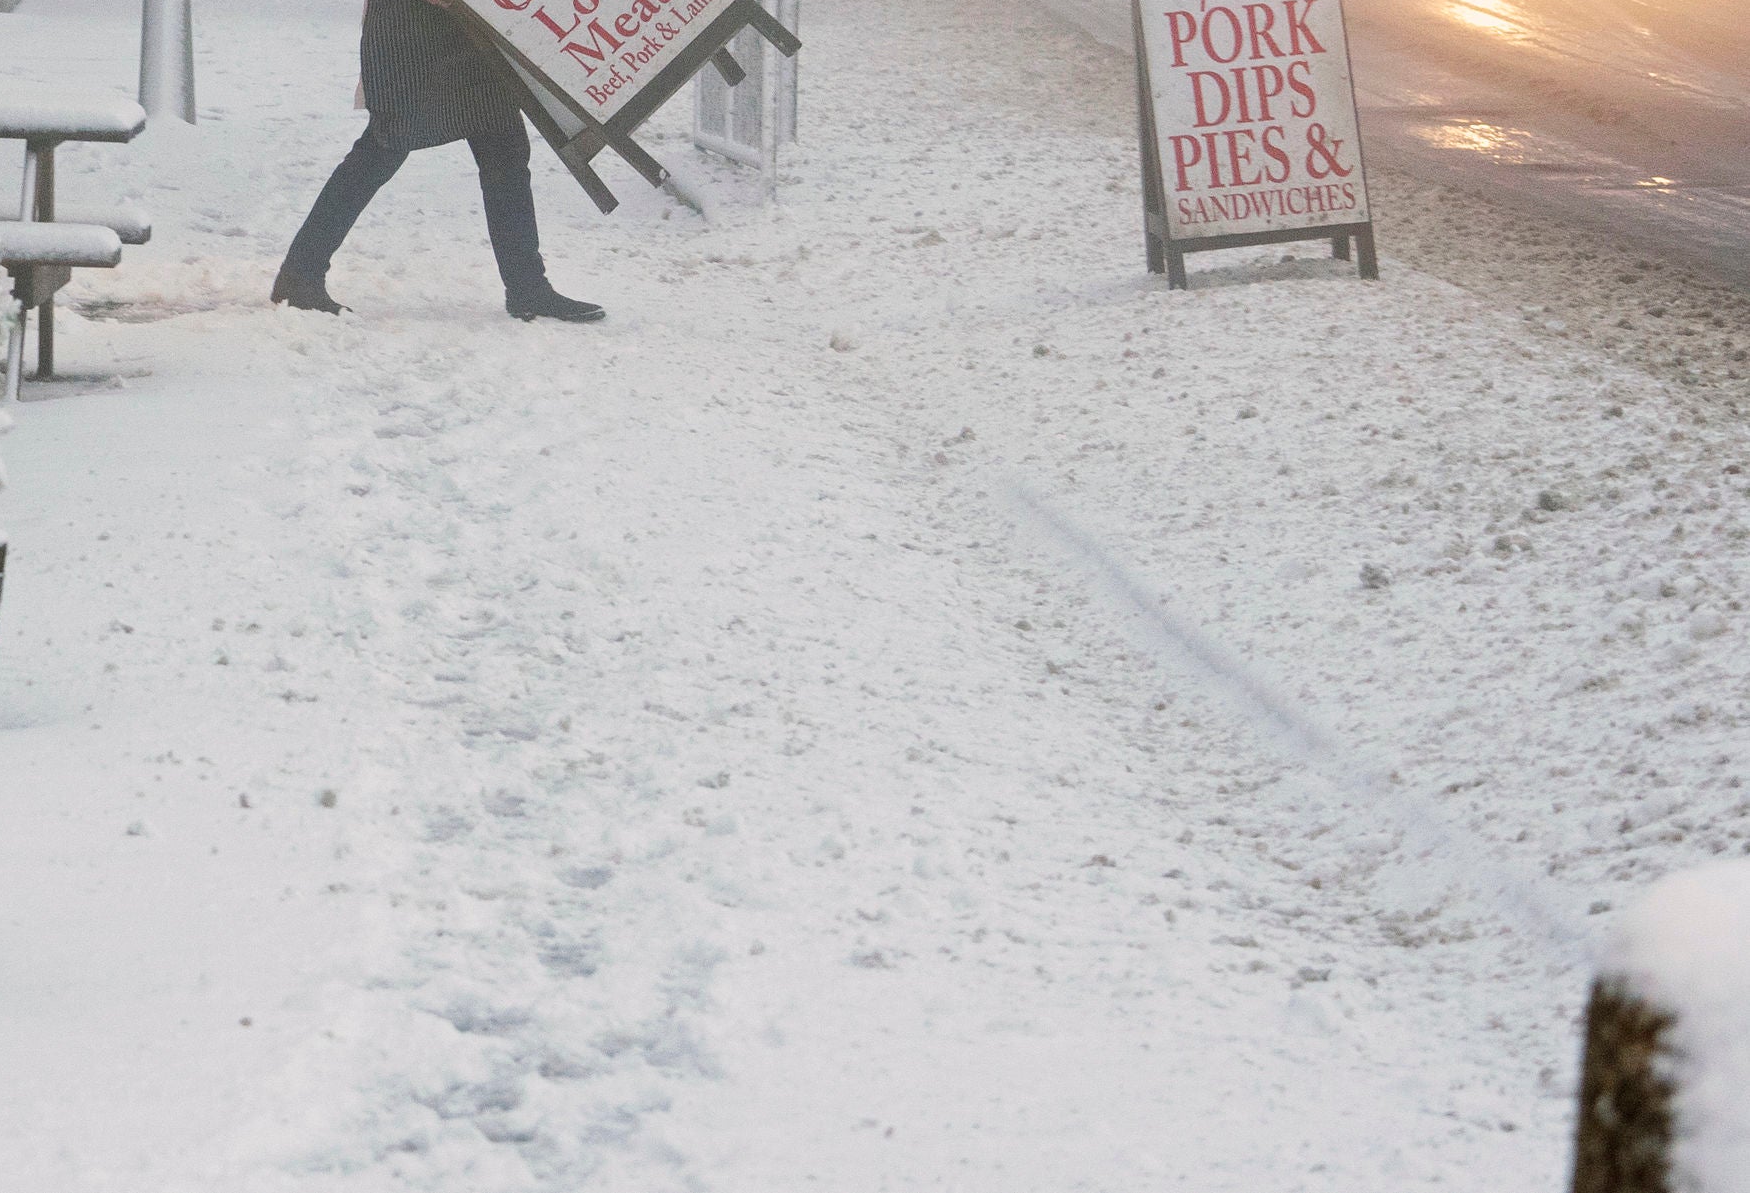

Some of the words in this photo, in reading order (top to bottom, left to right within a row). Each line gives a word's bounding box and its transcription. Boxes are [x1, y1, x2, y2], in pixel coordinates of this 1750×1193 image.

[584, 64, 634, 106] Beef,
[621, 35, 665, 73] Pork
[655, 22, 681, 41] &
[1186, 60, 1317, 128] DIPS
[1168, 125, 1291, 192] PIES
[1305, 122, 1353, 179] &
[1177, 182, 1357, 226] SANDWICHES
